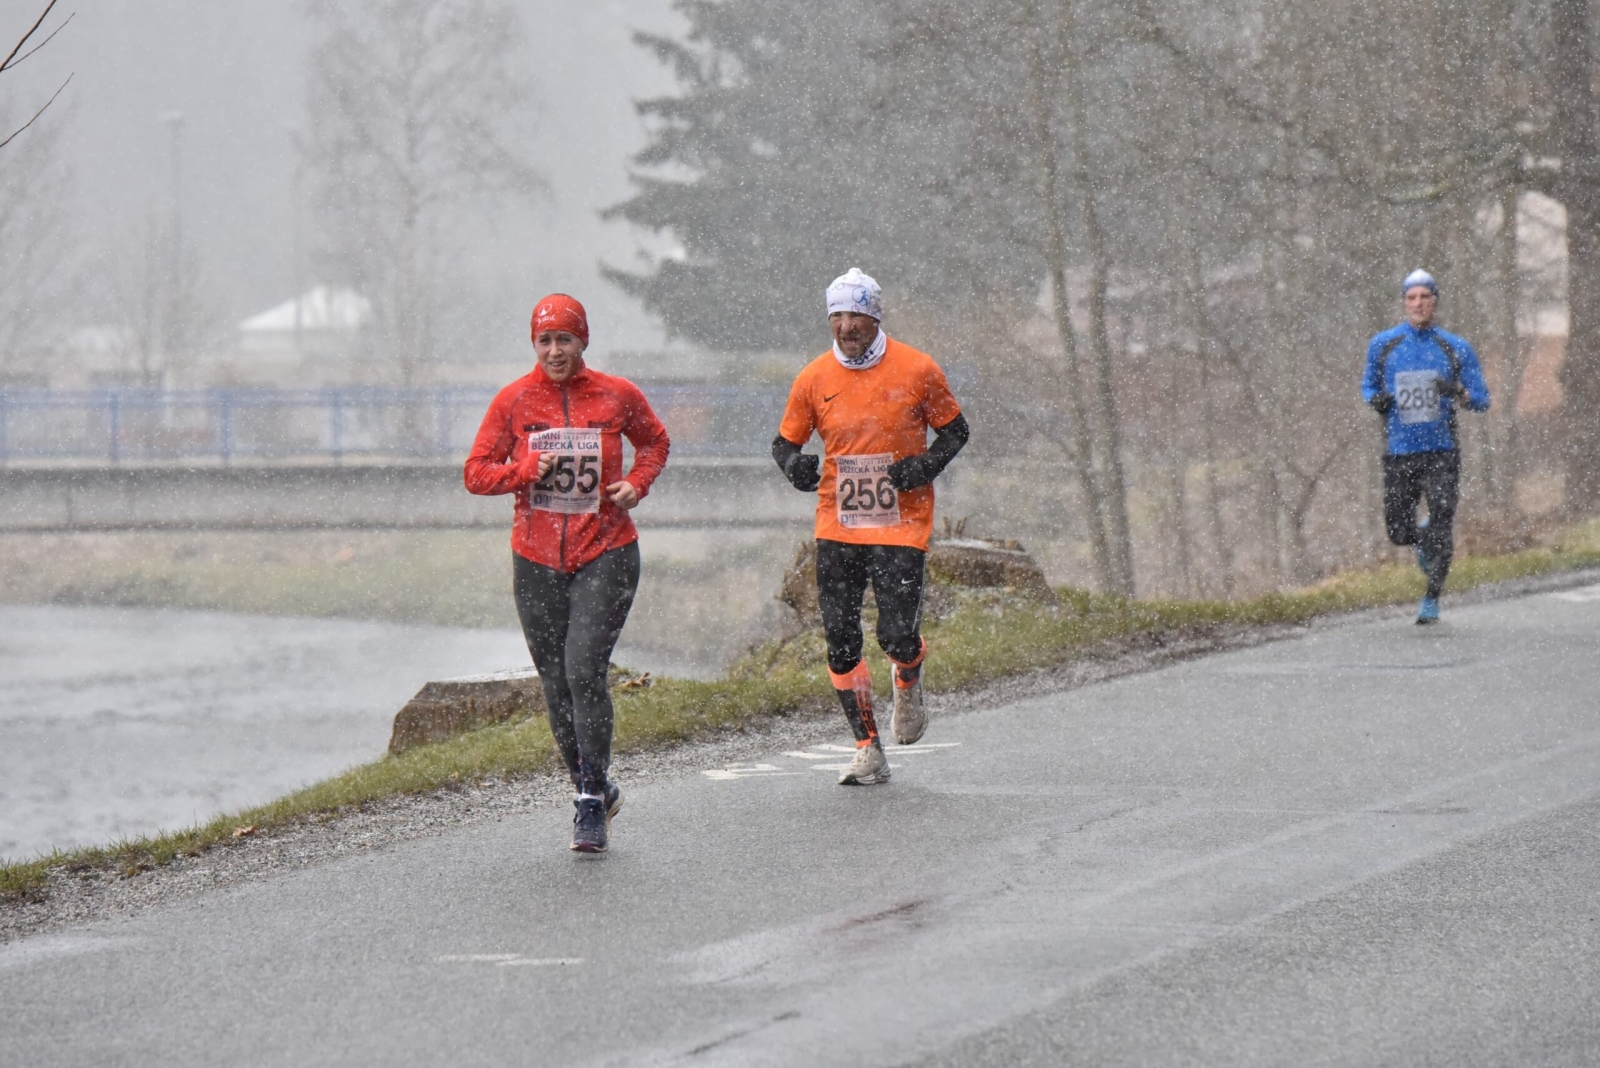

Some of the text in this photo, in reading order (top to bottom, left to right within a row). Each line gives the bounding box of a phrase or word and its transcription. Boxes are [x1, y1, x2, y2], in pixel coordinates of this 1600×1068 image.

[531, 440, 599, 450] BĚŽECKÁ LIGA
[533, 455, 599, 494] 255
[839, 476, 896, 511] 256
